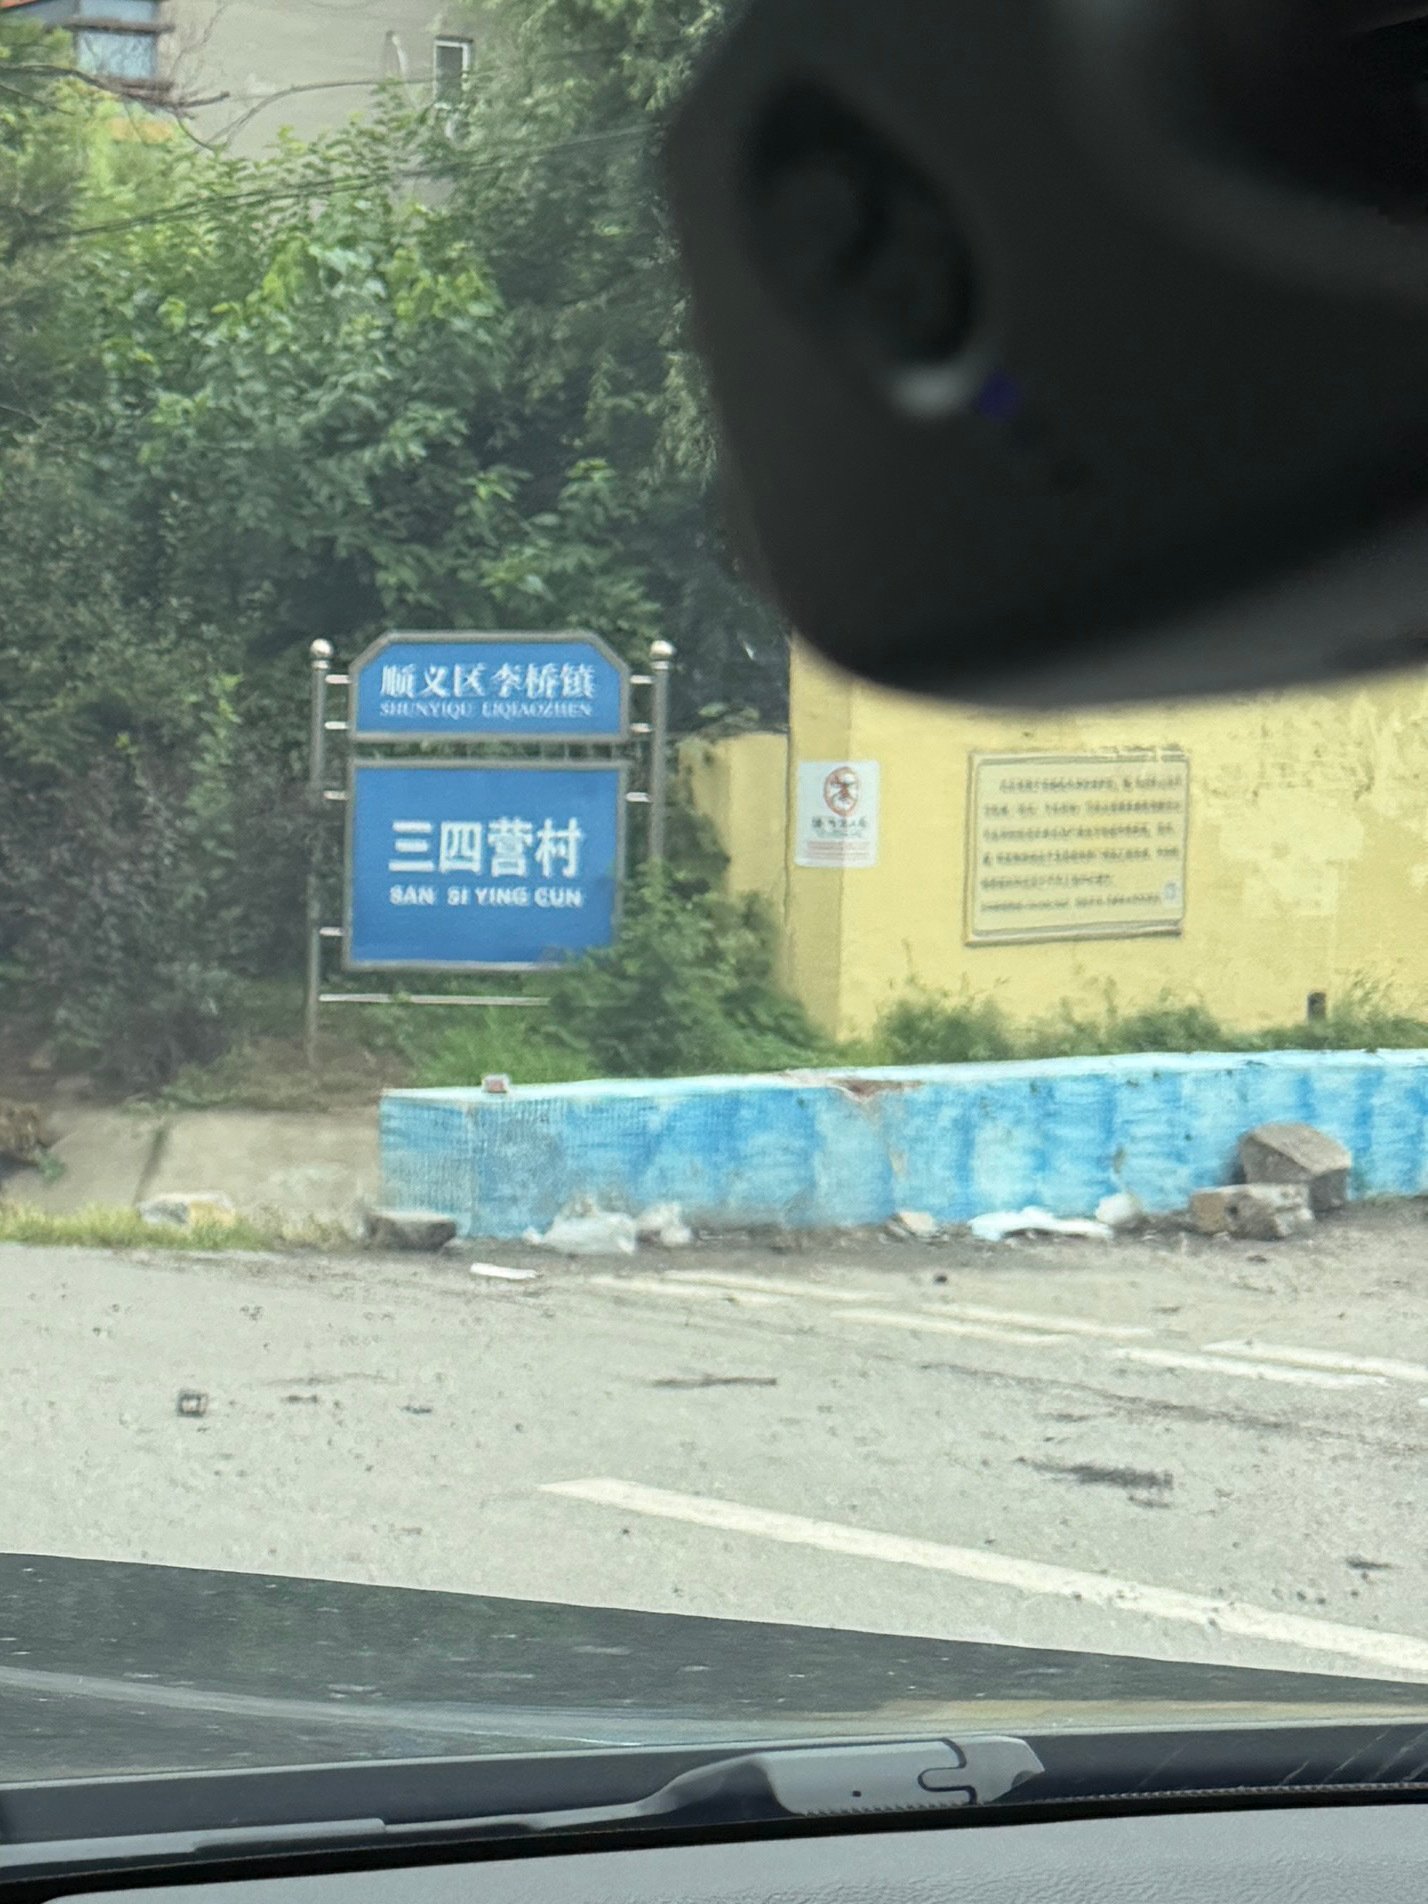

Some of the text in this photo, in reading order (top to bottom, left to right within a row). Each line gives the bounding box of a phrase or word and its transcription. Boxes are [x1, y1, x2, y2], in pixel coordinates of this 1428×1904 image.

[381, 663, 595, 699] 顺义区李桥镇
[380, 700, 593, 719] SHUNYIQU LIQIAOZHEN
[388, 816, 582, 878] 三四营村
[389, 884, 583, 908] SAN SI YING CUN
